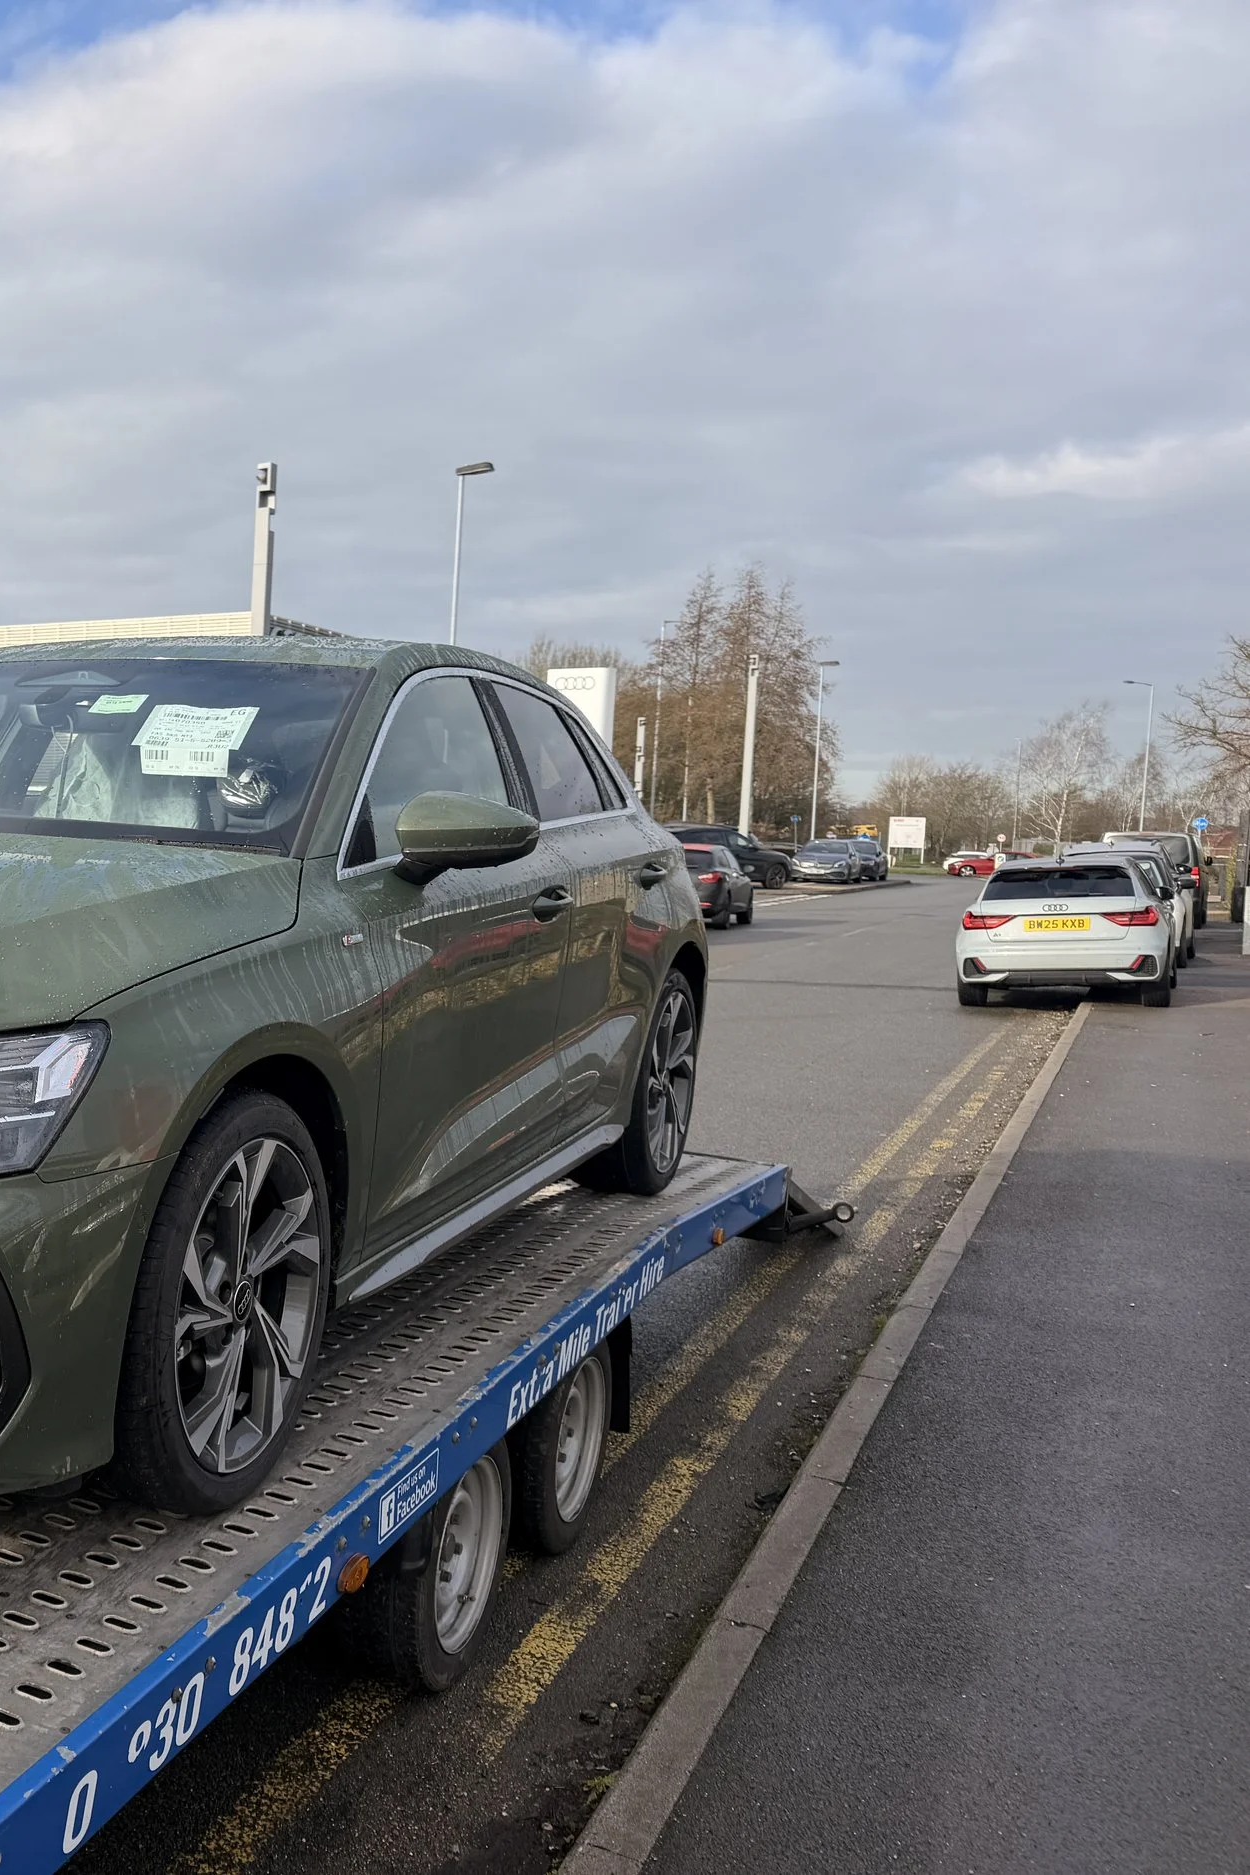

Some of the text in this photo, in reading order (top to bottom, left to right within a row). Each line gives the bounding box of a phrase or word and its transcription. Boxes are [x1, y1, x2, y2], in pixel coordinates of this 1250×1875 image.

[230, 708, 247, 717] EG
[1028, 918, 1085, 929] BW25 KXB
[556, 1323, 591, 1382] Mile
[595, 1280, 639, 1345] Traier
[638, 1255, 665, 1301] Hire
[396, 1471, 436, 1522] Facebook
[397, 1466, 426, 1499] Find us on
